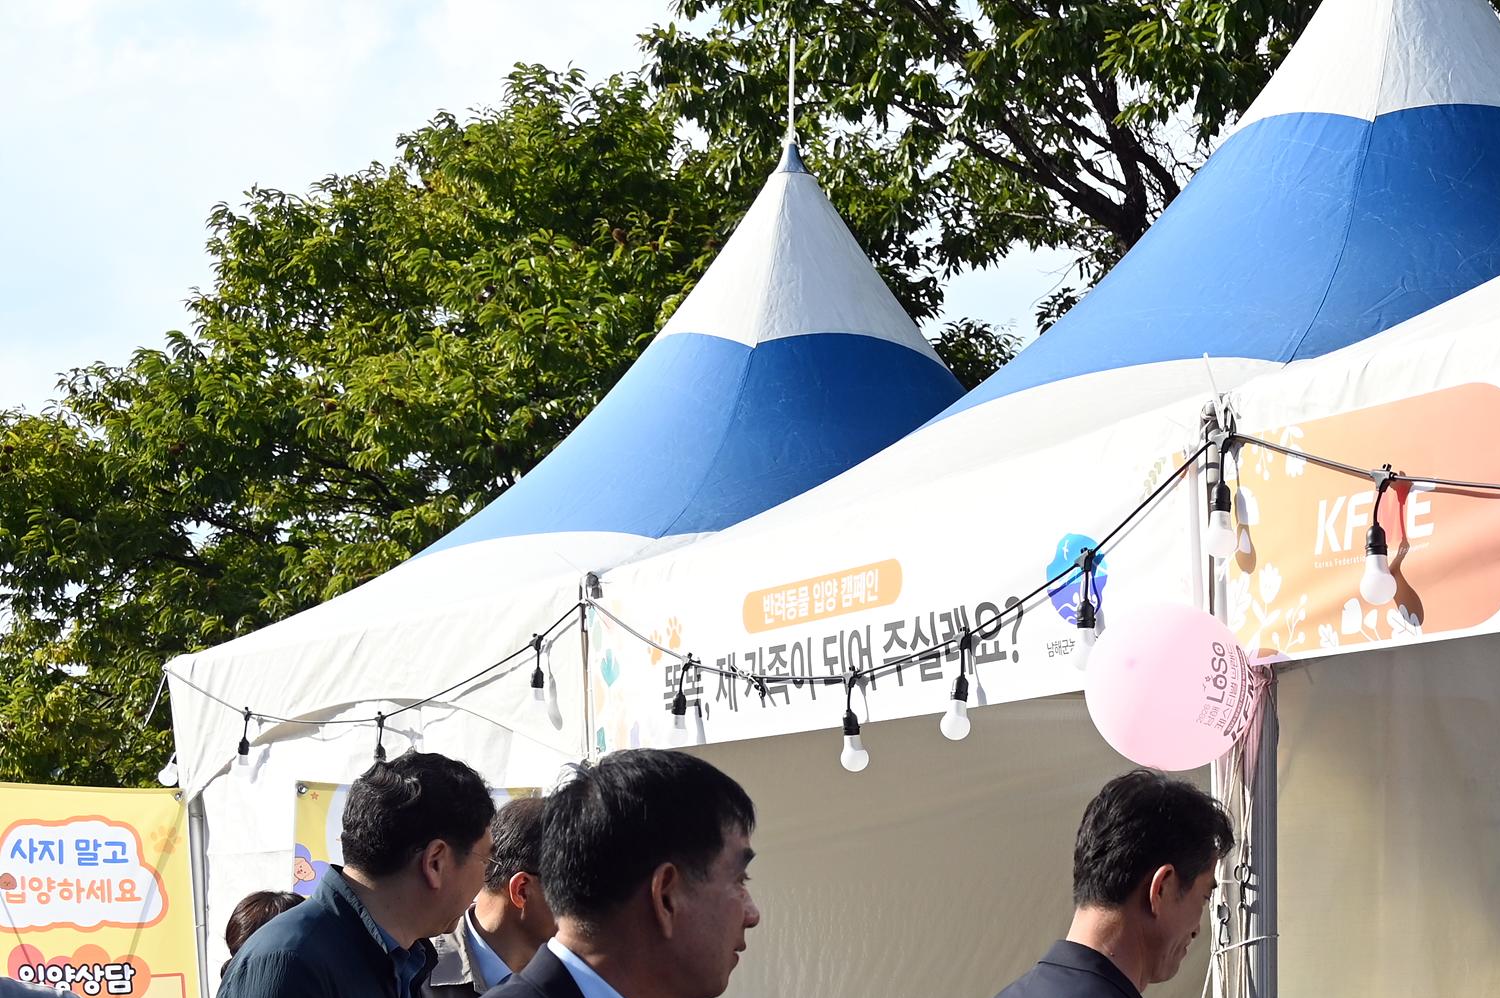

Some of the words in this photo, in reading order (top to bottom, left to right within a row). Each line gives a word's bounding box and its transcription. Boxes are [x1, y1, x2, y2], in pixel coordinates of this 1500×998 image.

[762, 586, 811, 625] 반려동물
[812, 579, 838, 613] 입양
[841, 569, 879, 608] 캠페인
[823, 625, 876, 697] 되어
[10, 838, 64, 865] 사지
[74, 838, 129, 866] 말고
